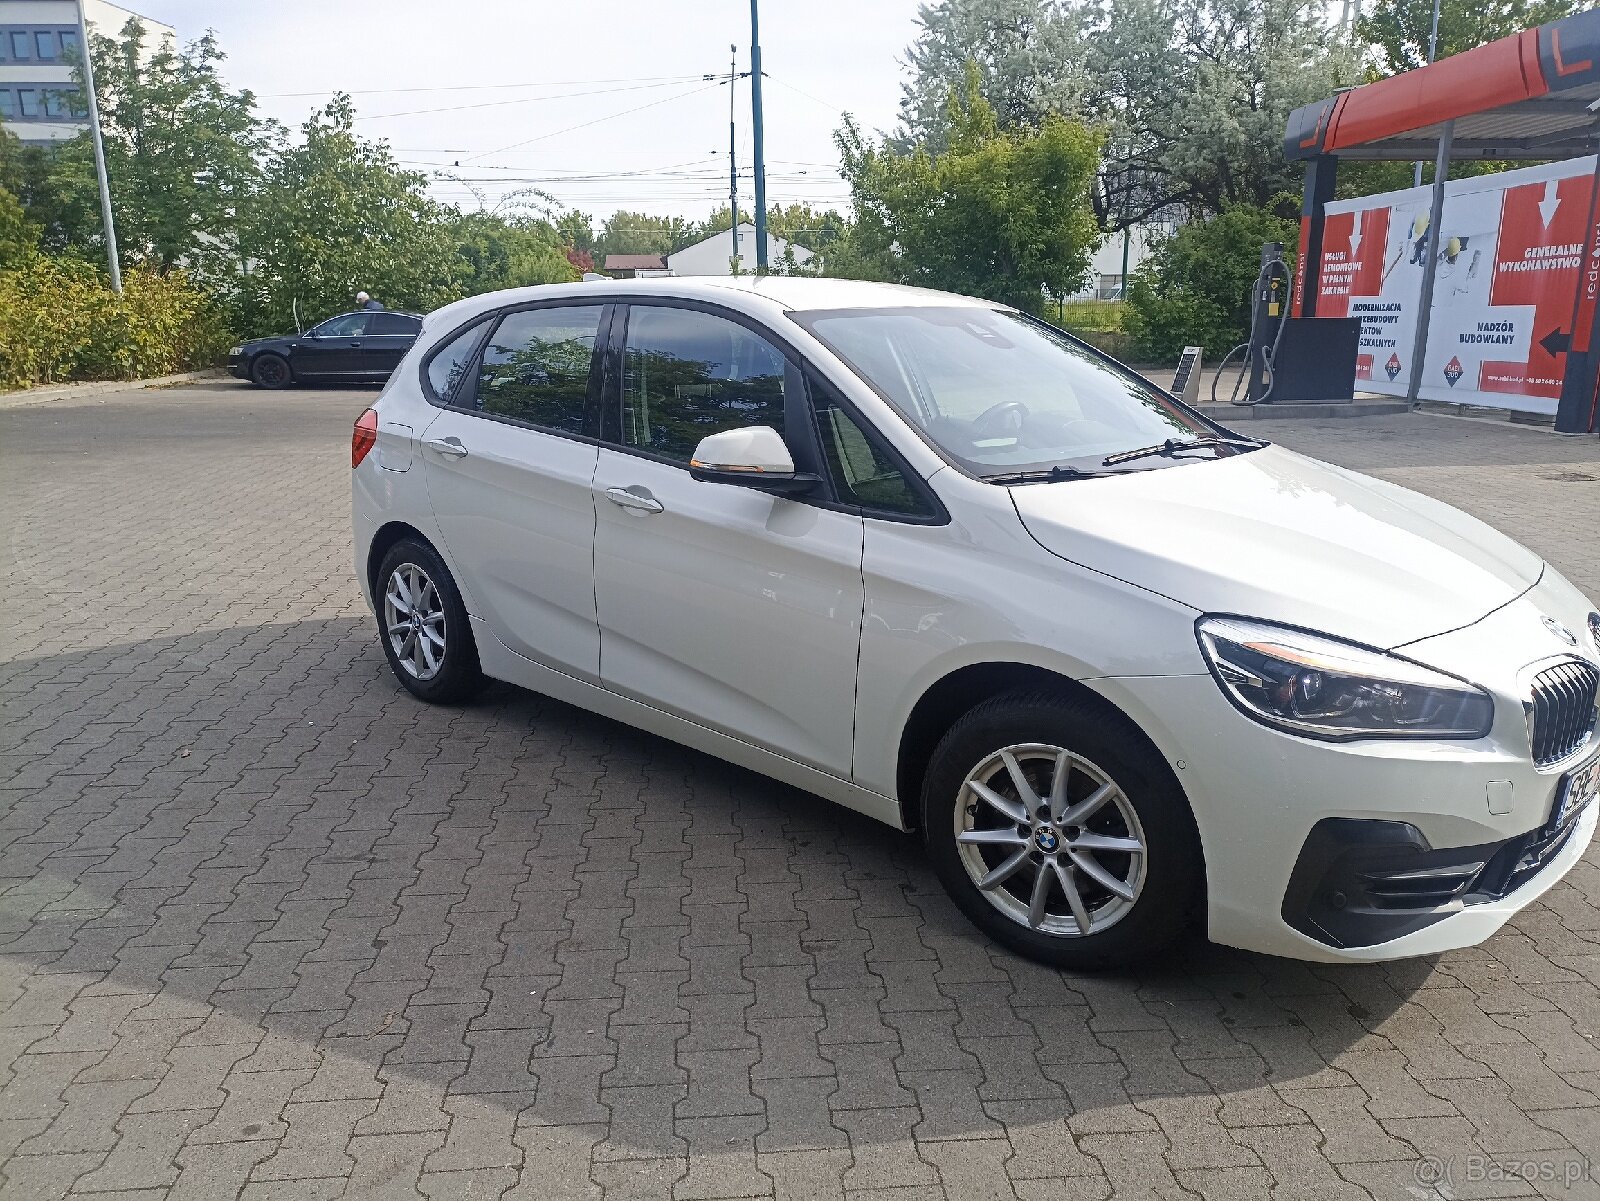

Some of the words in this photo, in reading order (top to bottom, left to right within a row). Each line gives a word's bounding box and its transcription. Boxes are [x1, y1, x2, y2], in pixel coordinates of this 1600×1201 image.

[1525, 244, 1583, 258] GENERALNE
[1500, 256, 1580, 272] WYKONAWSTWO
[1352, 303, 1401, 311] MODERNIZACJA
[1477, 320, 1514, 332] NADZÓR
[1459, 333, 1515, 344] BUDOWLANY
